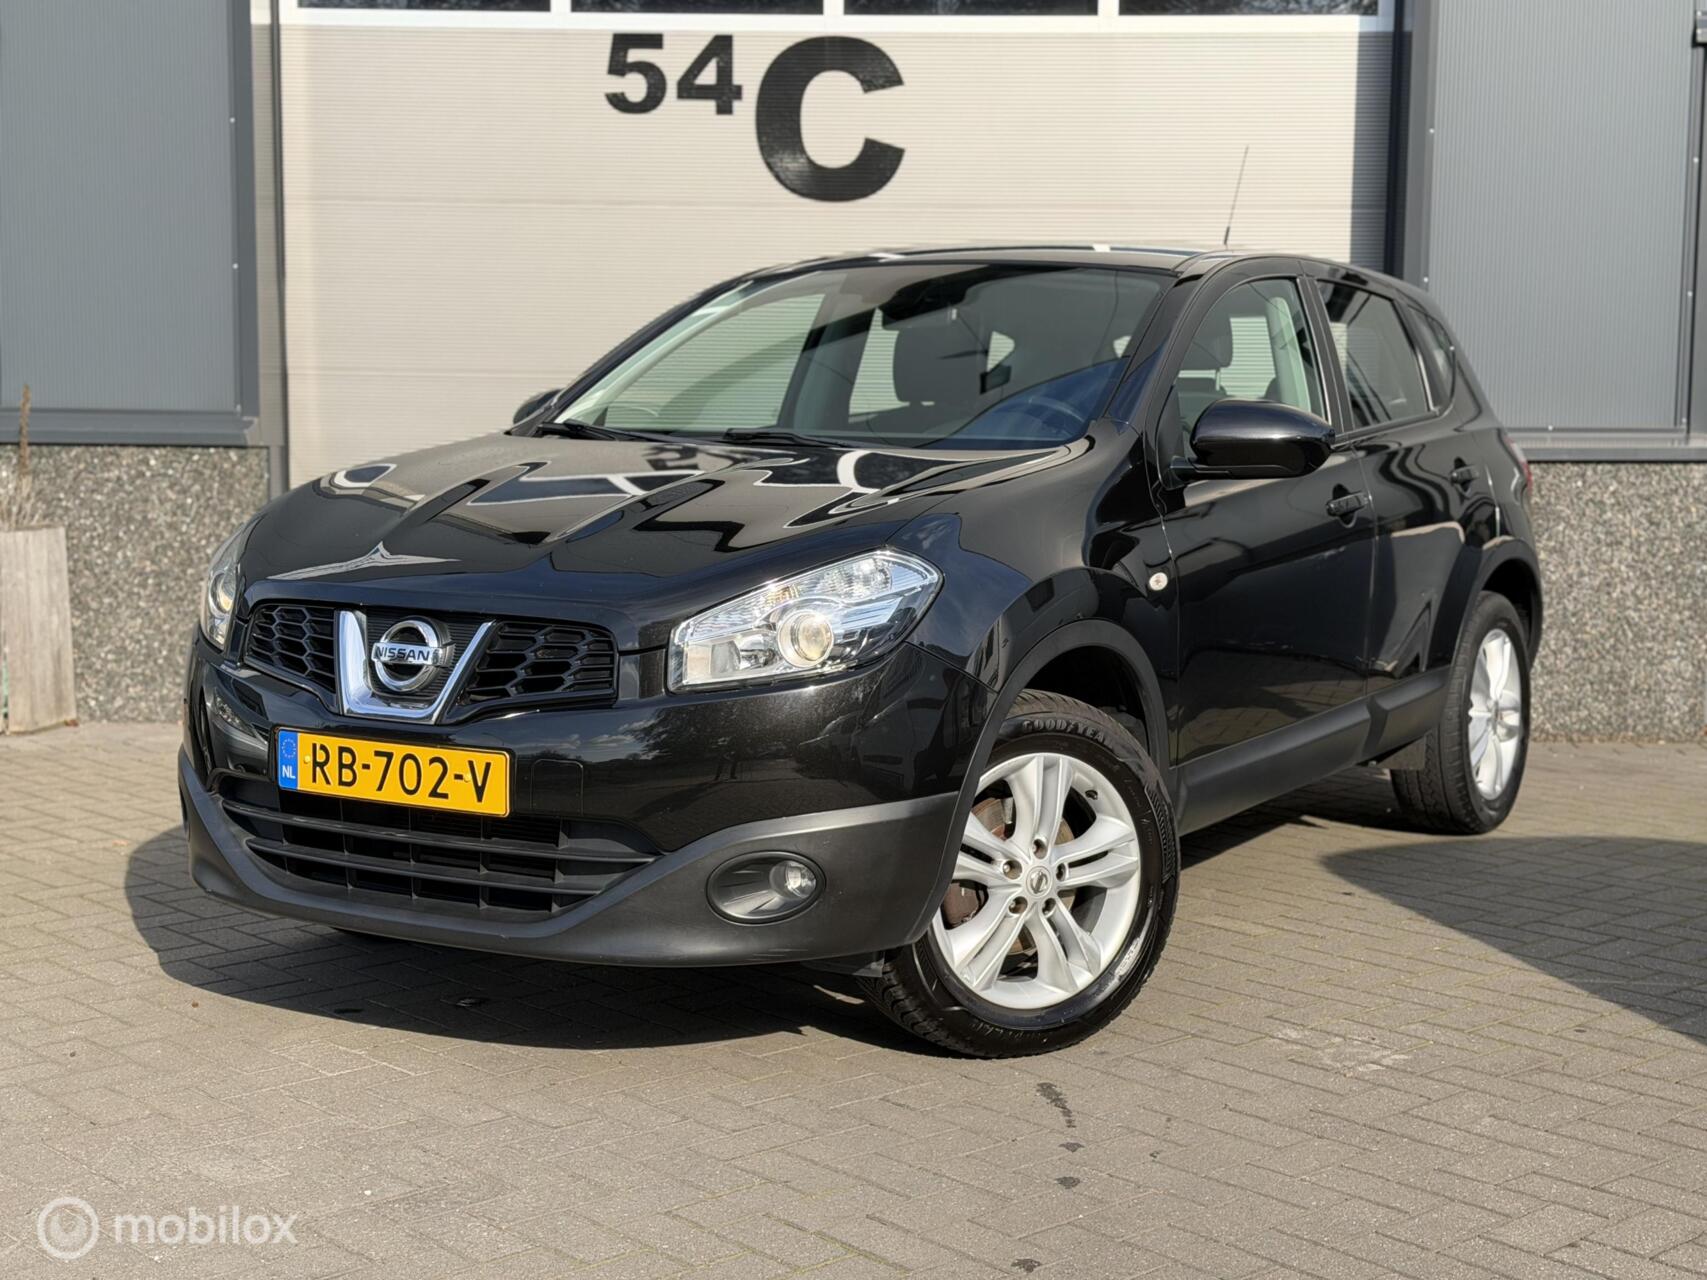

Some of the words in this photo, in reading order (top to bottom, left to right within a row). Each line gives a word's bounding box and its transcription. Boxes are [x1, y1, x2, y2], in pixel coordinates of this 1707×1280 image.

[374, 645, 430, 661] NISSAN
[282, 764, 297, 780] NL
[311, 742, 492, 803] RB-702-V
